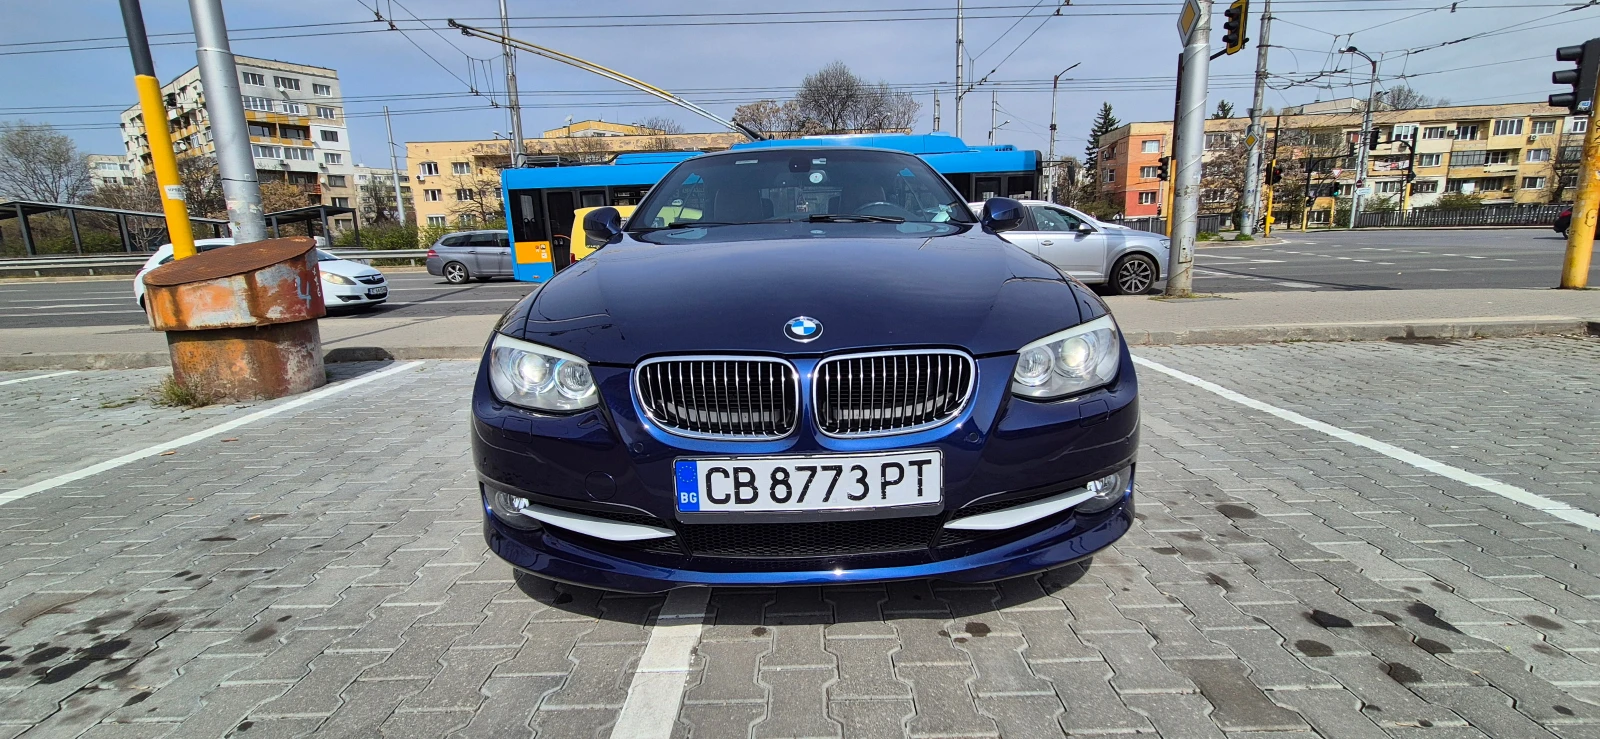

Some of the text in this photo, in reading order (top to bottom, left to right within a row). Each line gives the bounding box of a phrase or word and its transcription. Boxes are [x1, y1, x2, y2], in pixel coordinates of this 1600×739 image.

[705, 459, 932, 505] CB 8773 PT
[680, 491, 697, 504] BG
